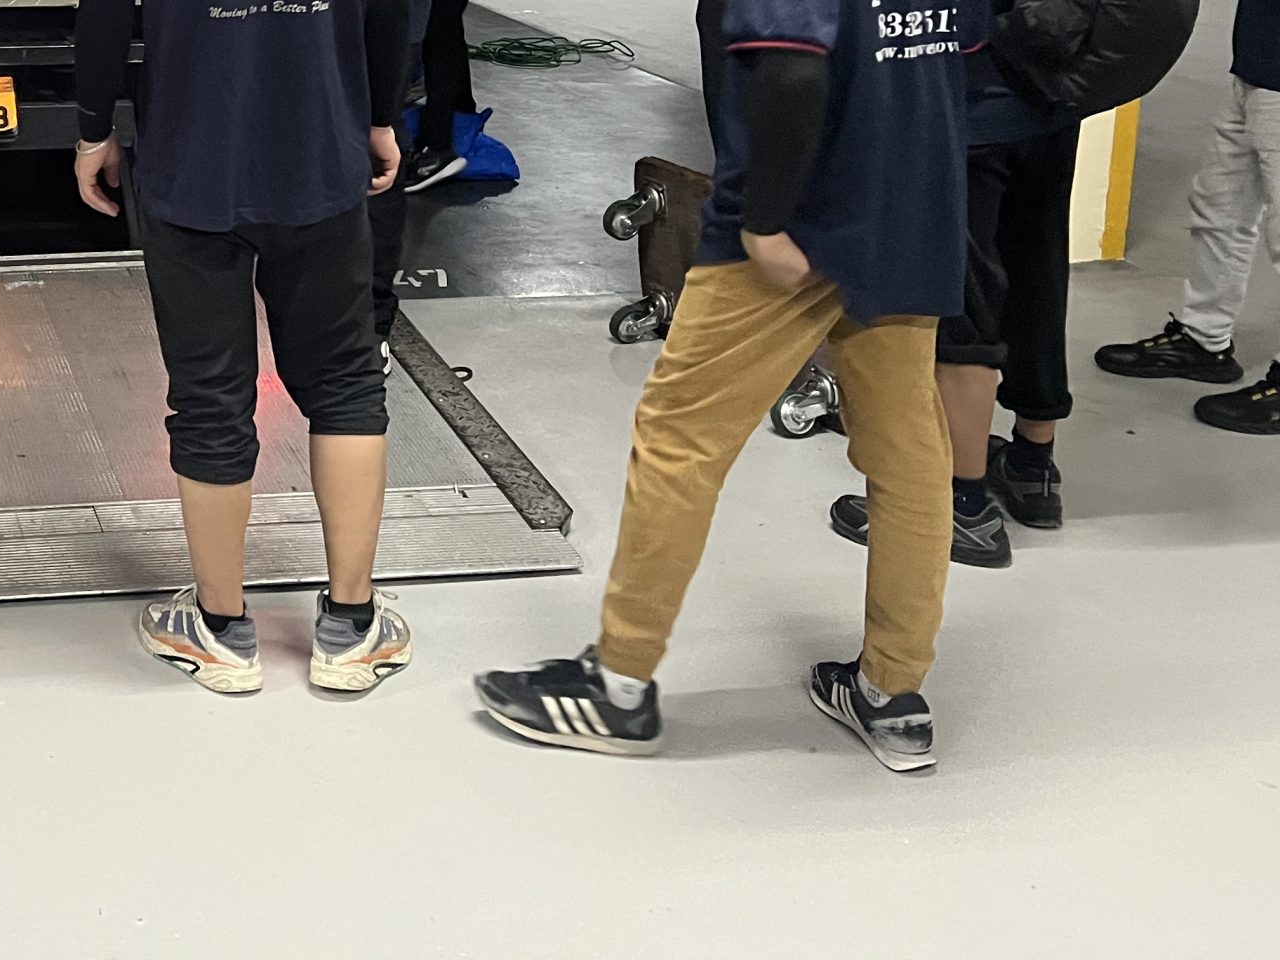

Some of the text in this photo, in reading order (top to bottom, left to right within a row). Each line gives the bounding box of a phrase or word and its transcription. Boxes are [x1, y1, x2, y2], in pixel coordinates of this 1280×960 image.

[209, 6, 248, 20] Moving
[249, 4, 258, 14] to
[260, 4, 268, 13] a
[273, 0, 308, 13] Better
